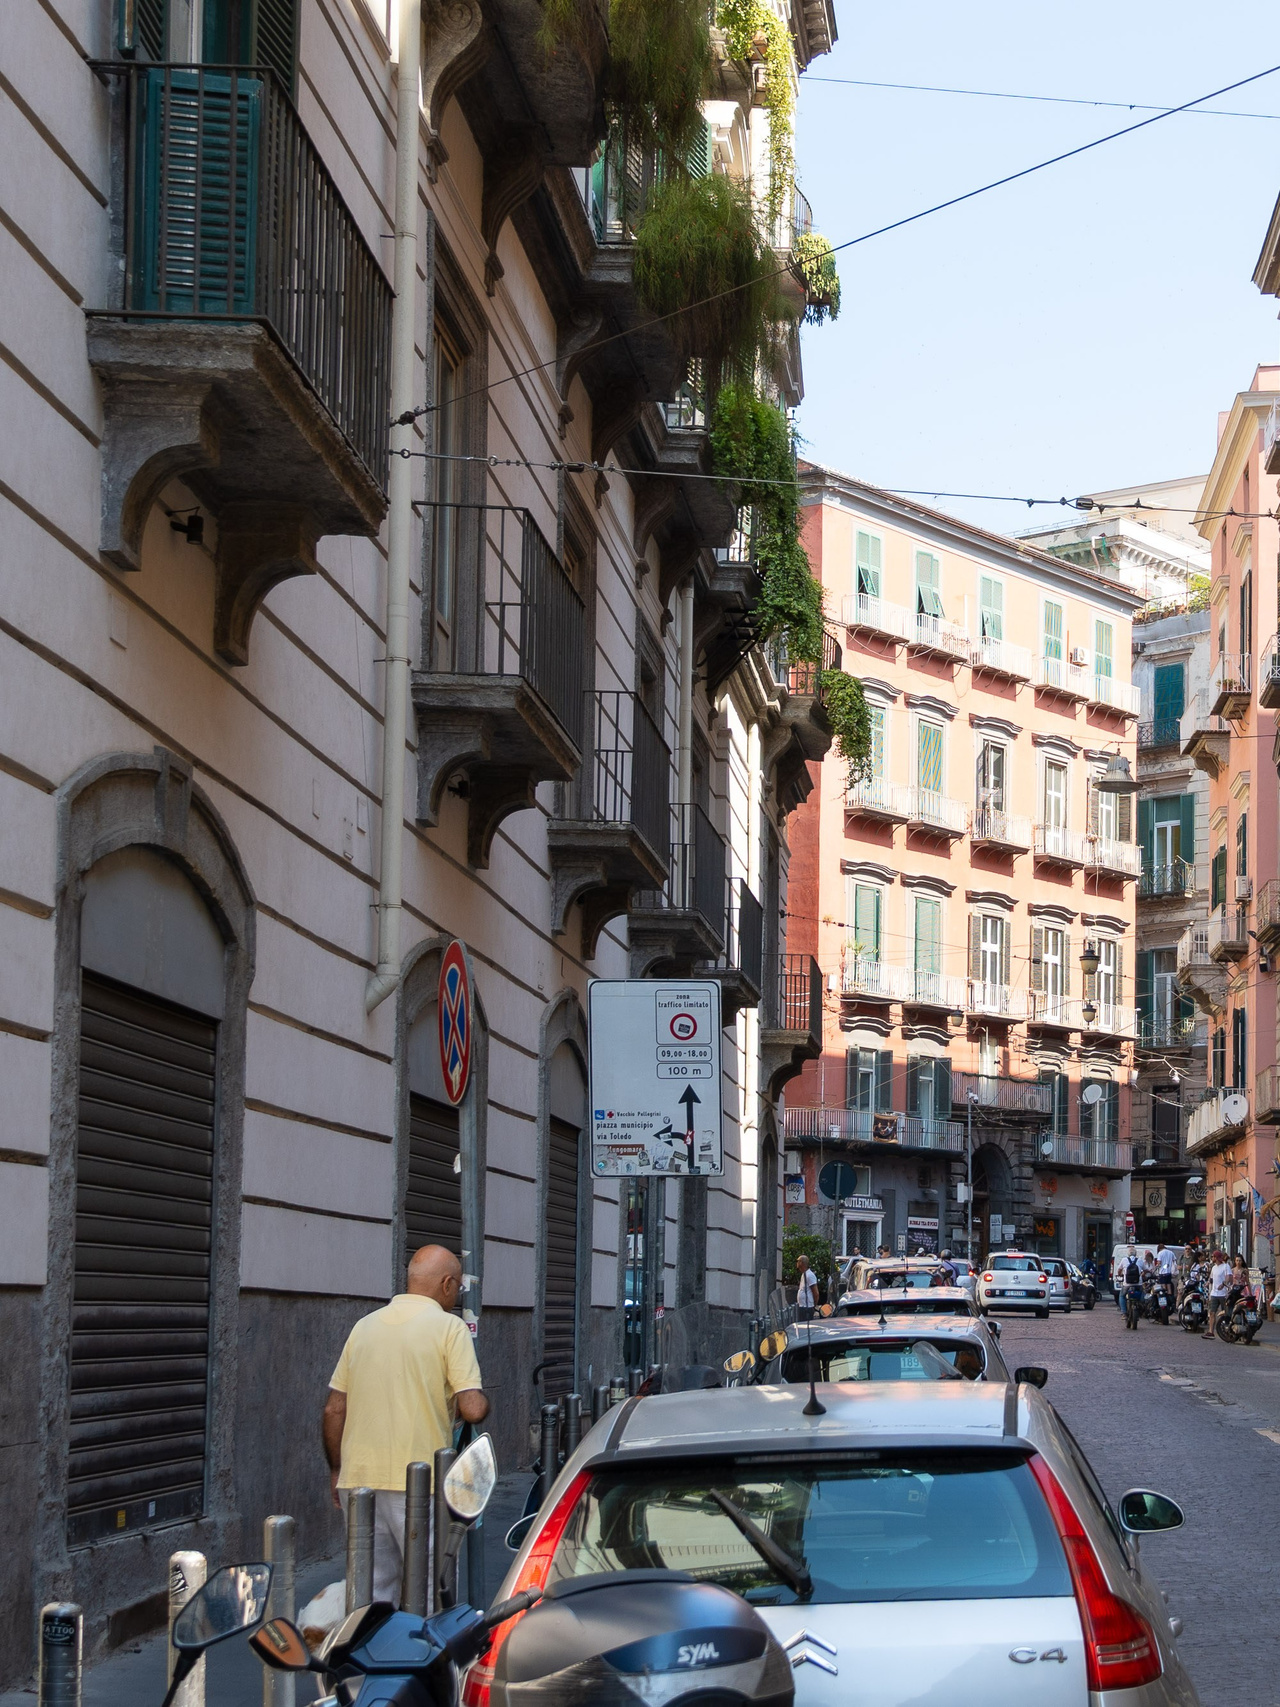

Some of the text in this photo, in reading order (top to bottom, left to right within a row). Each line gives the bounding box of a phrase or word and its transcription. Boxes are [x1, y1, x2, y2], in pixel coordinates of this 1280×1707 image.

[668, 1066, 688, 1075] 100
[597, 1121, 654, 1130] piazza municipio
[610, 1132, 632, 1140] Toledo
[844, 1197, 883, 1209] OUTLETMANIA
[678, 1641, 720, 1665] SYM
[1008, 1646, 1068, 1663] C4
